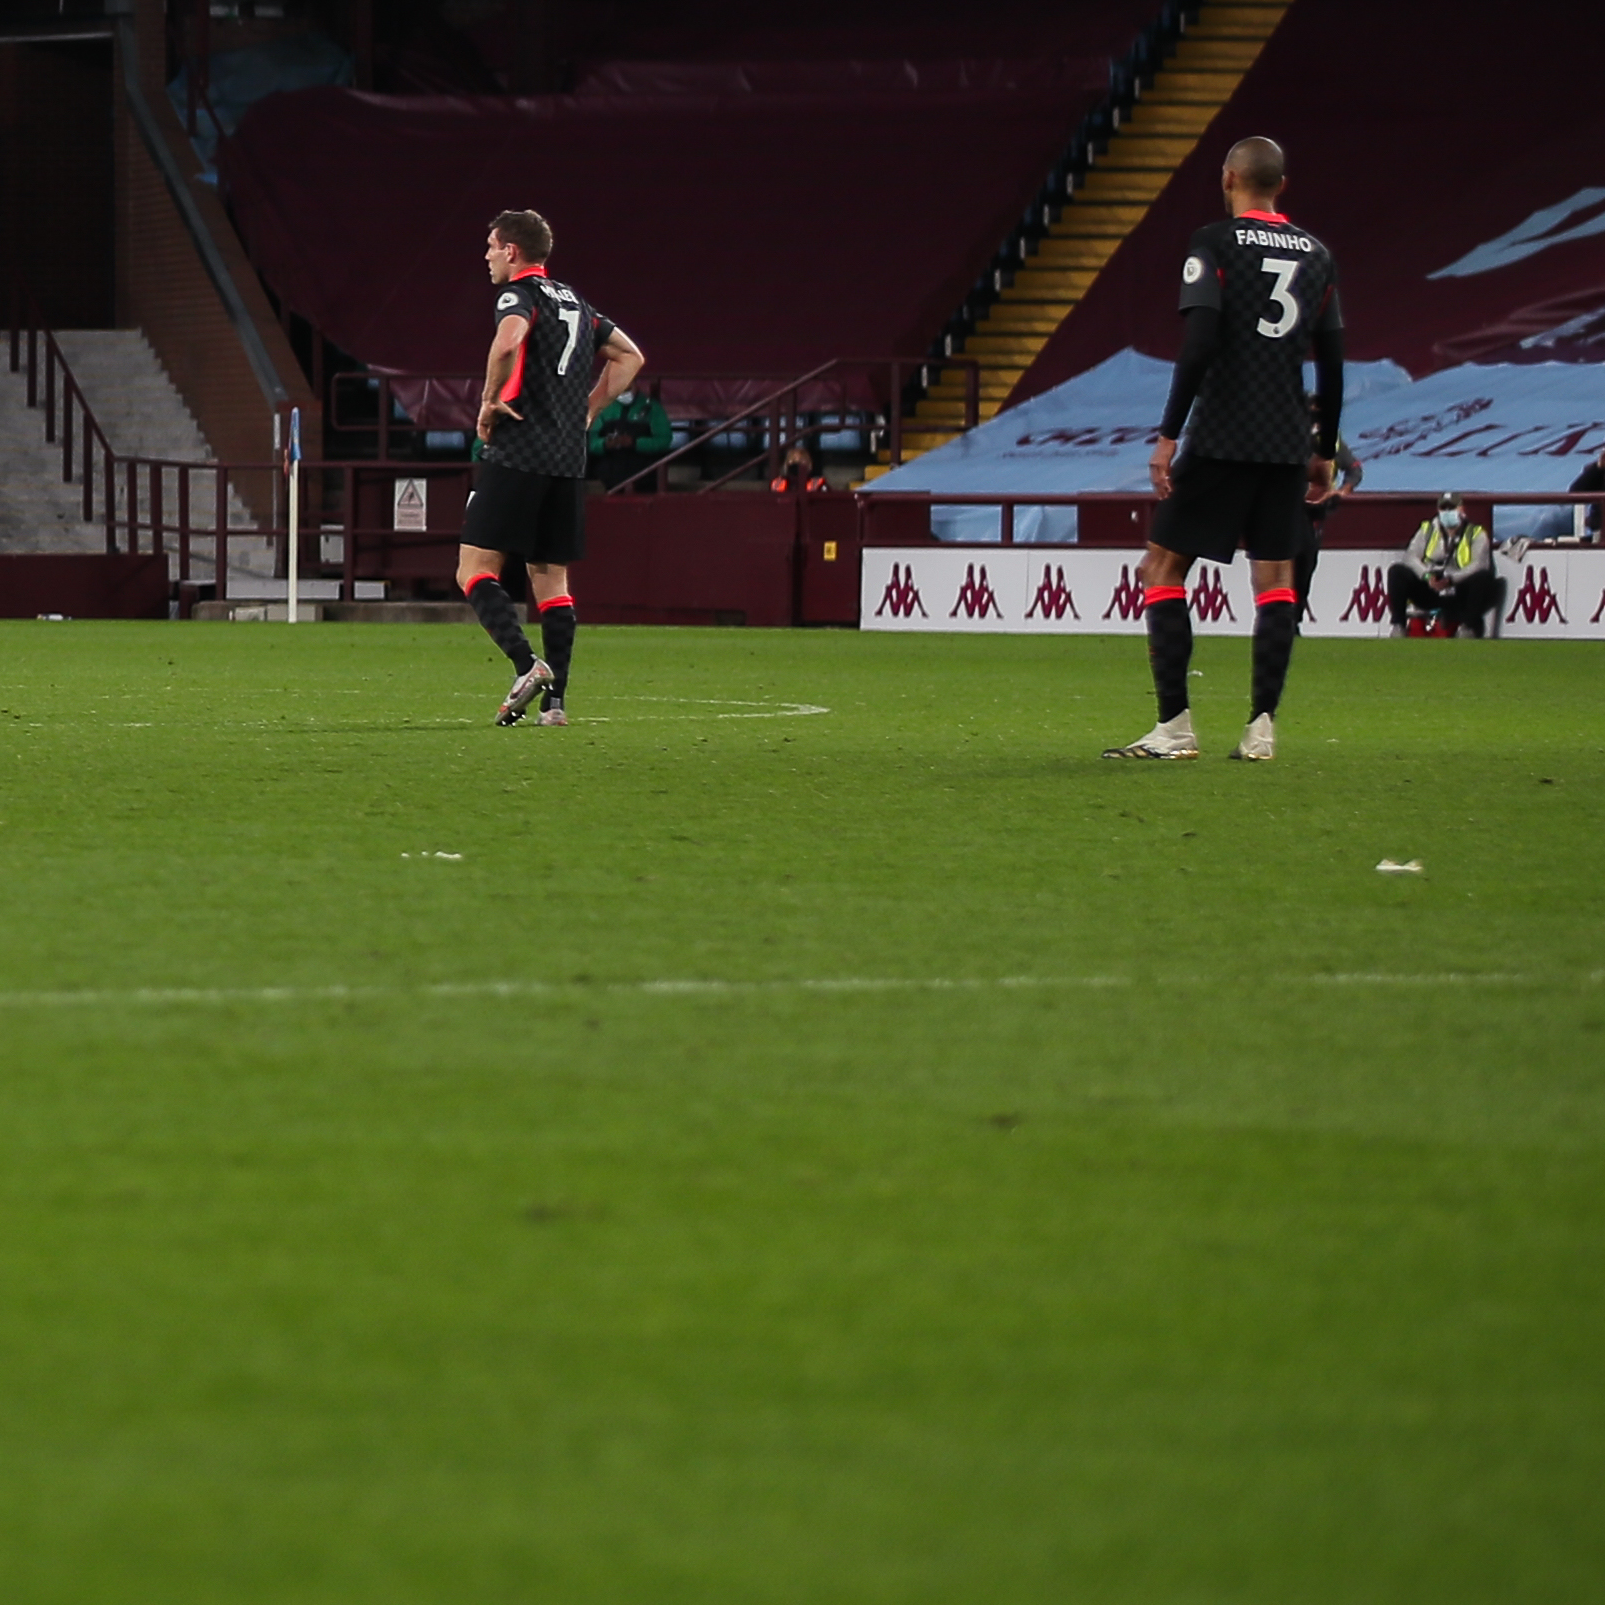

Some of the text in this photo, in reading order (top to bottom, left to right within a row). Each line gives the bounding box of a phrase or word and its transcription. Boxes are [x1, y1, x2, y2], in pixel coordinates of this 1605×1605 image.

[1235, 229, 1312, 253] FABINHO
[1256, 257, 1300, 339] 3
[557, 307, 580, 376] 7
